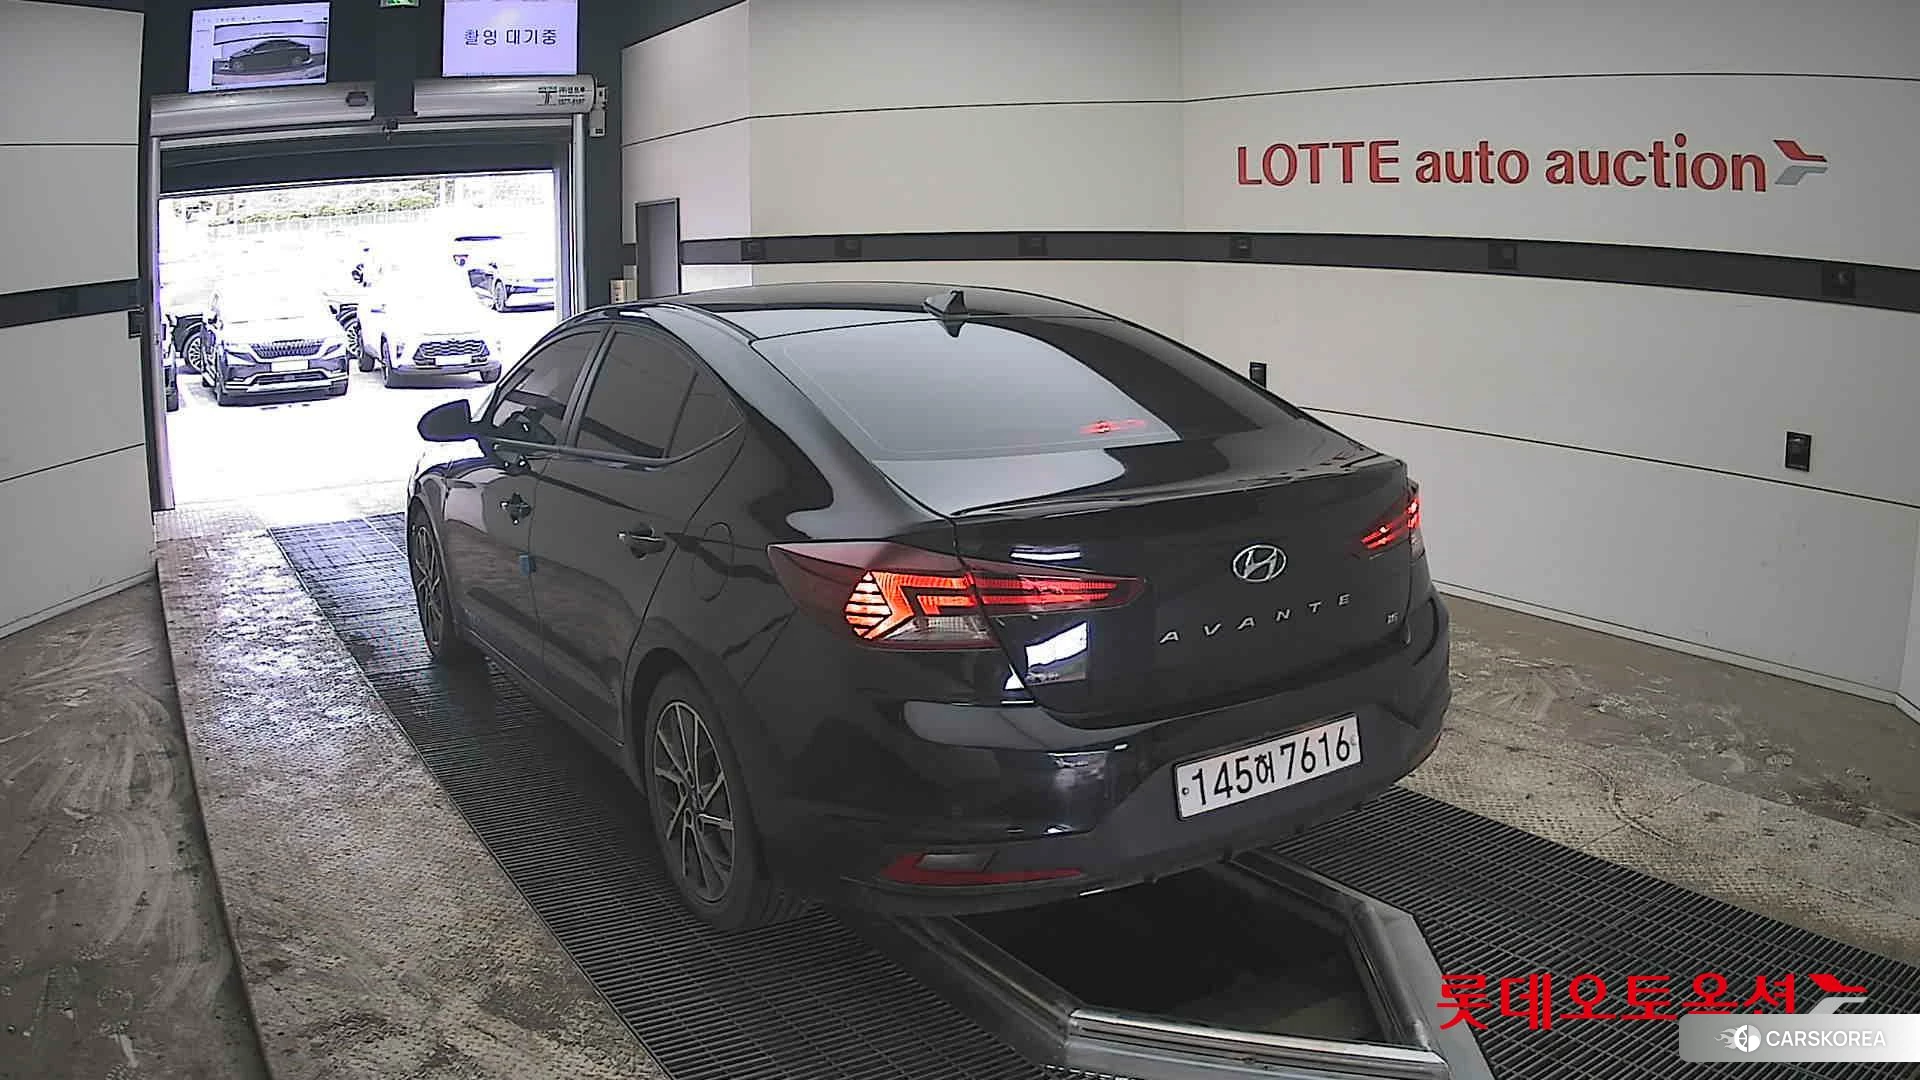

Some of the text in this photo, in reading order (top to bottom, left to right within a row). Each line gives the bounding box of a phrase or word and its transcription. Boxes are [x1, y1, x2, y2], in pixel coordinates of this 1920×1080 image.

[506, 28, 557, 46] 대기중
[1237, 132, 1767, 193] LOTTE auto auction
[1159, 593, 1351, 644] AVANTE
